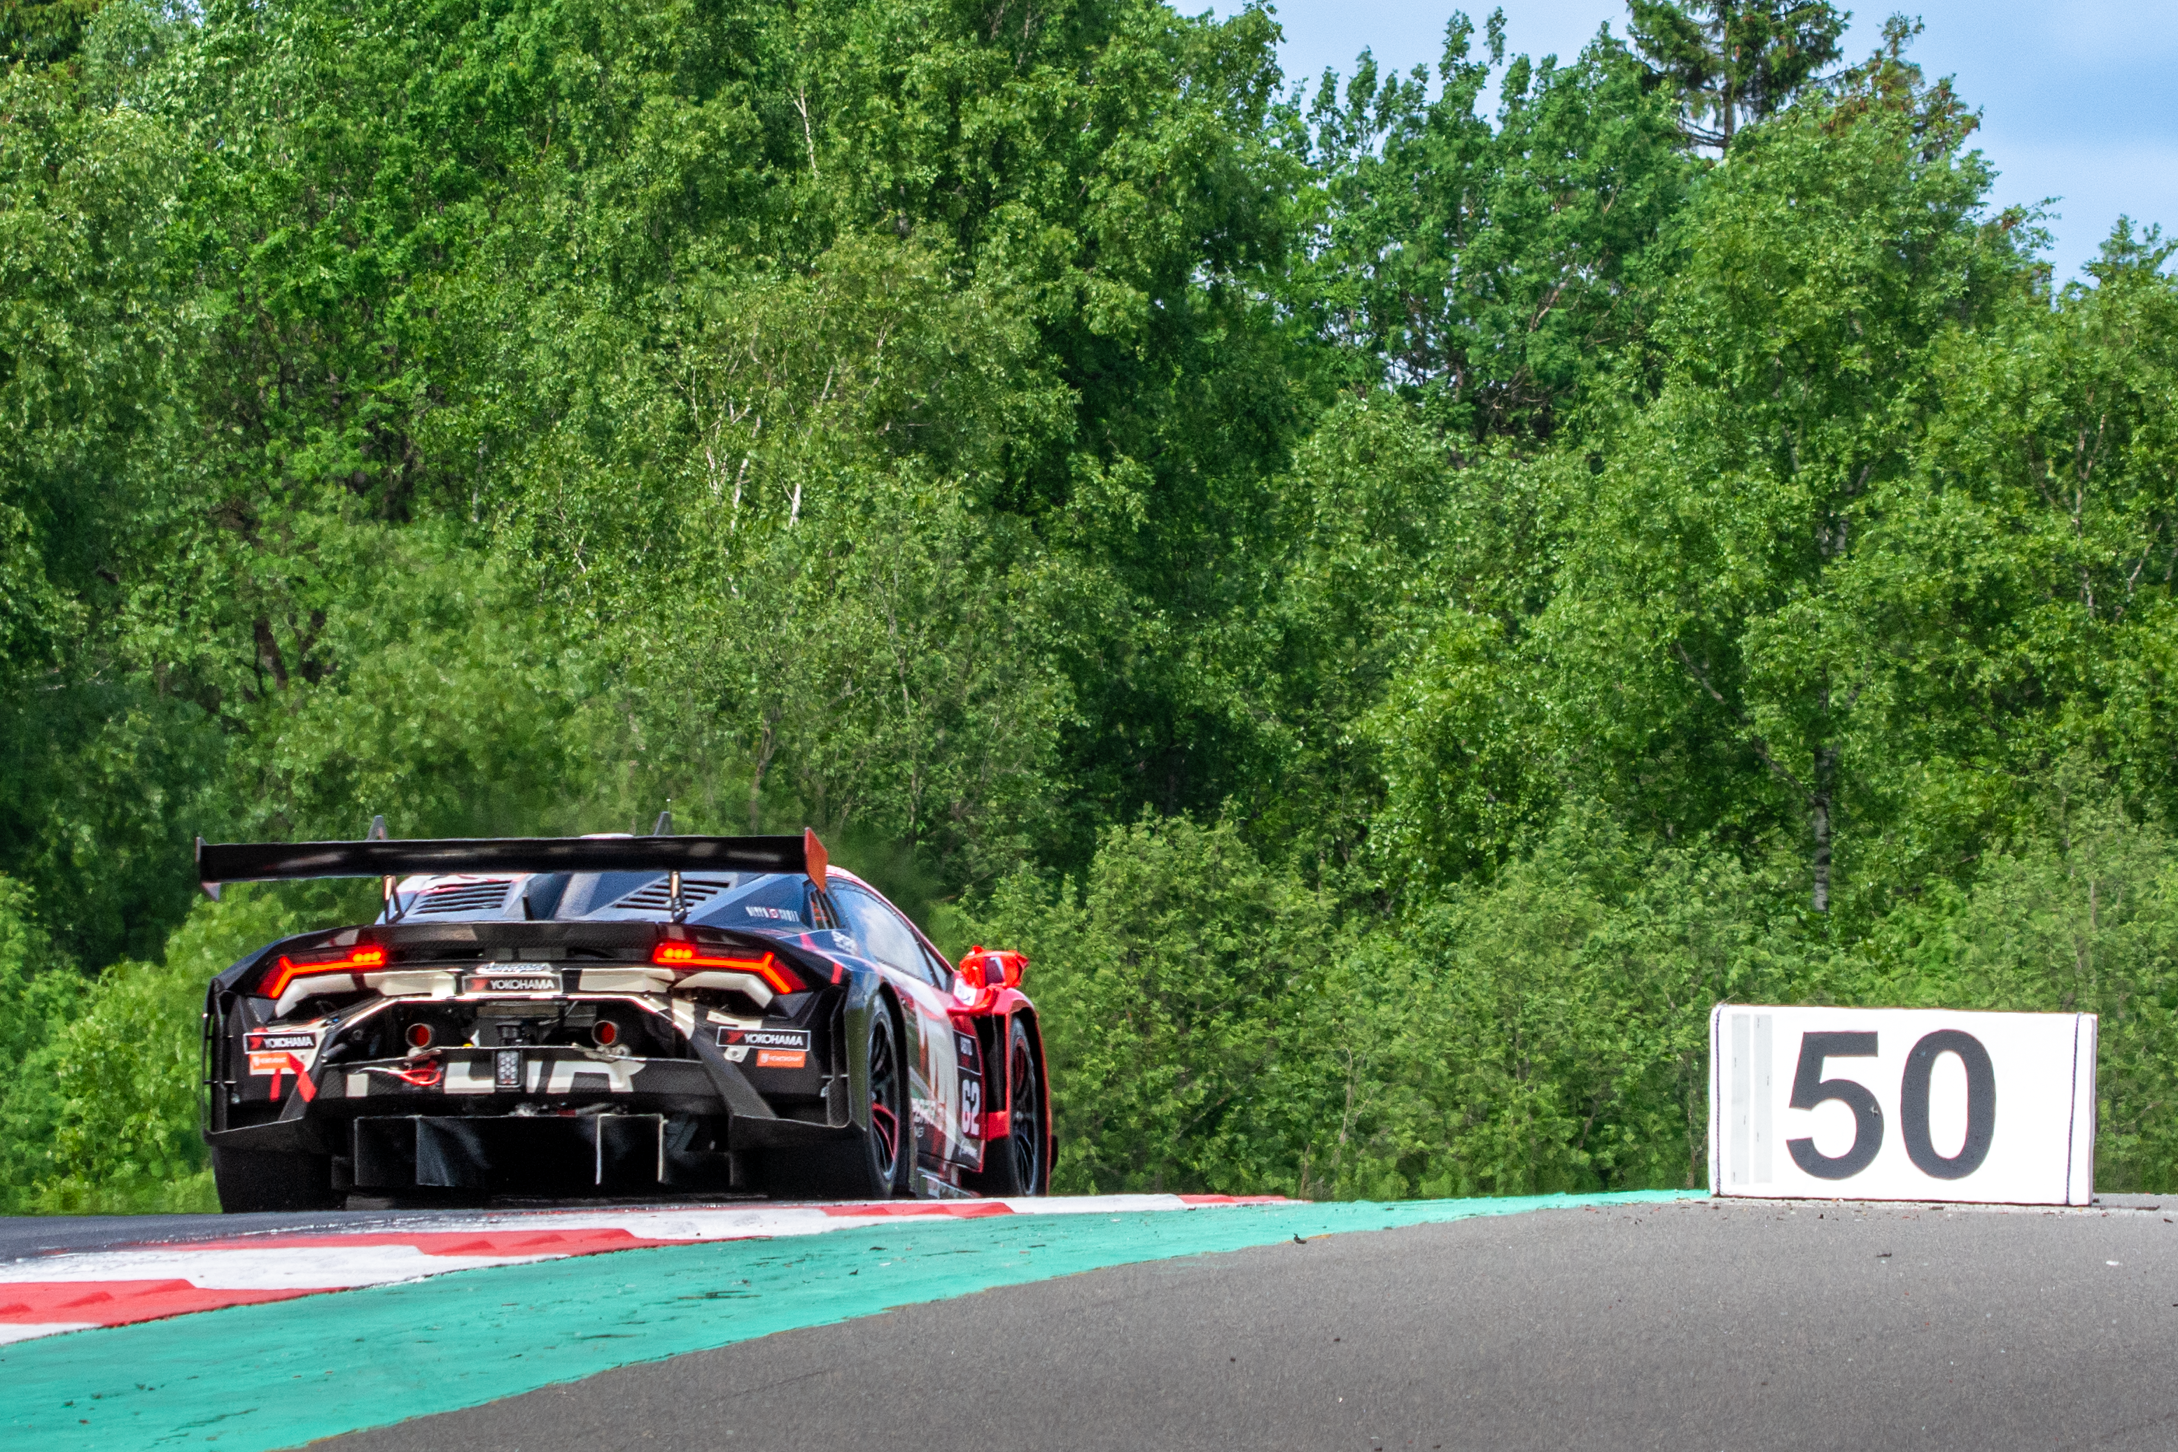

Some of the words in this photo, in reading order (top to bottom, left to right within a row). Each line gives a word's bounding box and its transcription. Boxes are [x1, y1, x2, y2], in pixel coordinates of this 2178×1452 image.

[490, 979, 555, 990] YOKOHAMA
[263, 1035, 315, 1049] YOKOHAMA
[743, 1033, 804, 1047] YOKOHAMA
[962, 1079, 980, 1136] 62
[1785, 1028, 1996, 1181] 50
